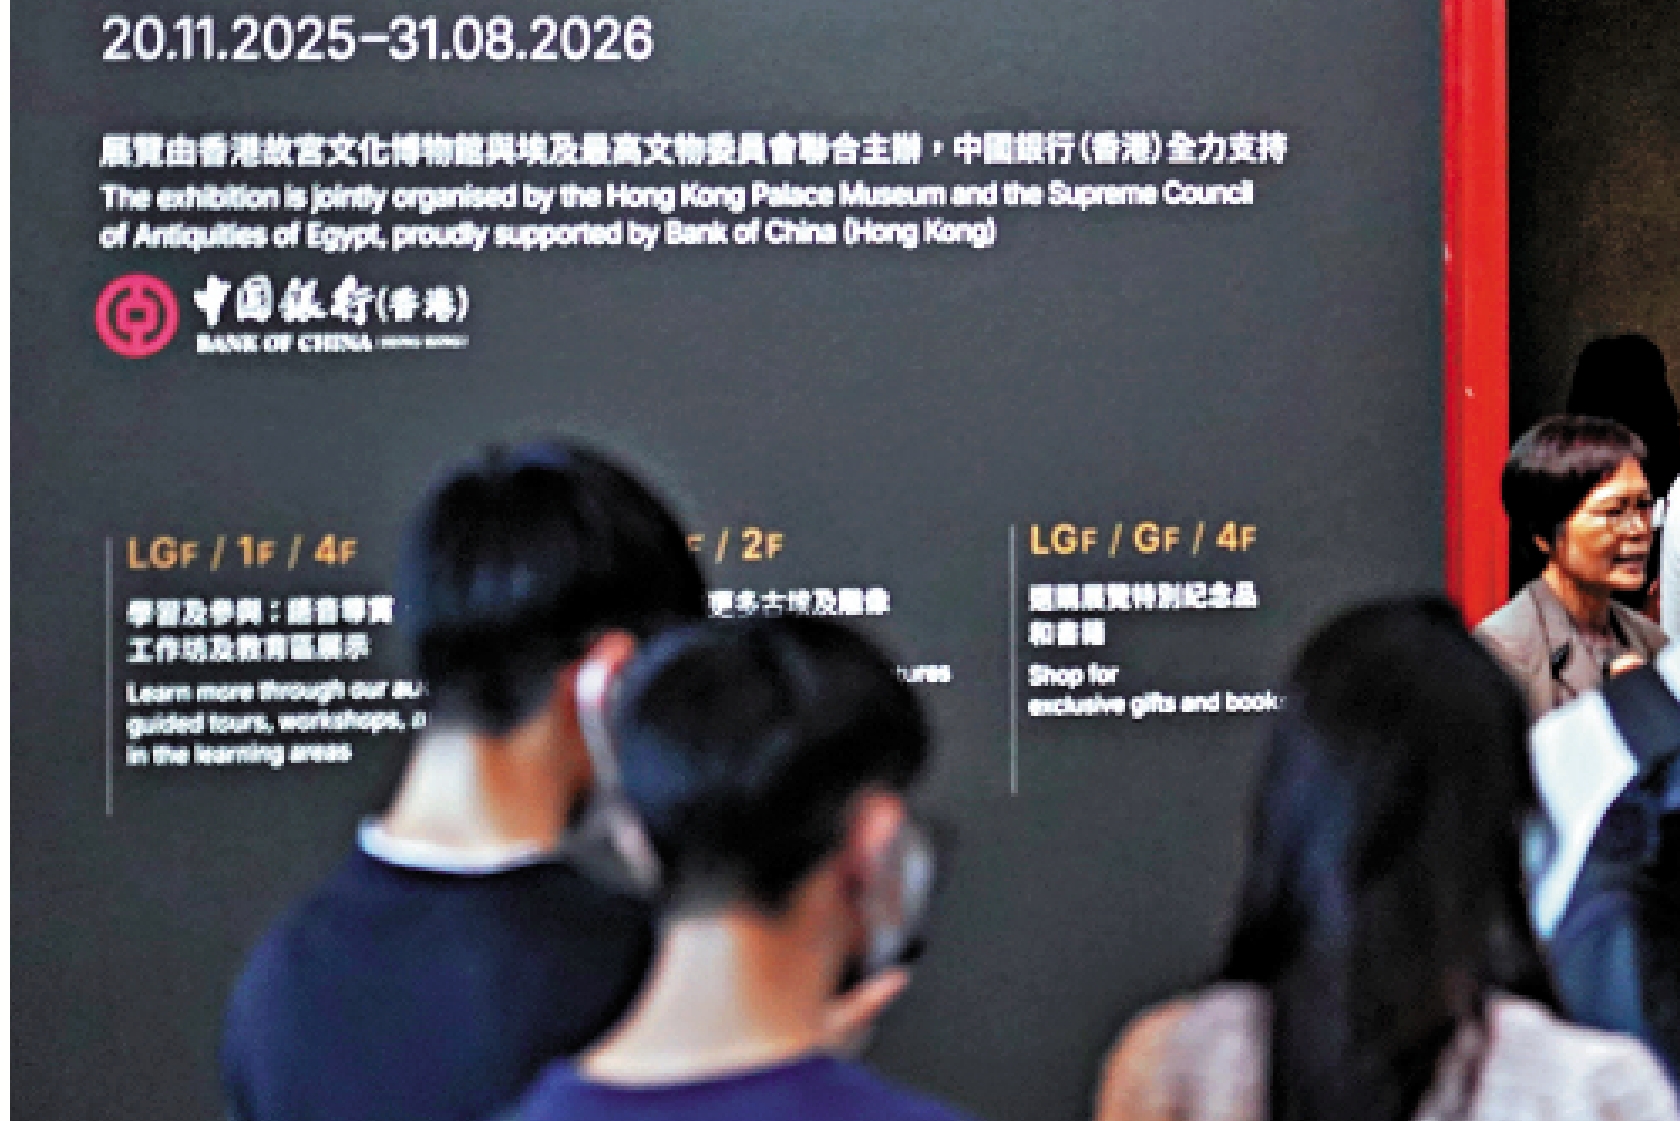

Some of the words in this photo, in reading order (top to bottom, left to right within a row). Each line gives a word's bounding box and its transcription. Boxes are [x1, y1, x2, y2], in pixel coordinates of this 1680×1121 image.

[98, 183, 153, 212] The
[156, 183, 278, 212] exhibition
[283, 183, 309, 212] is
[310, 183, 388, 215] jointly
[391, 183, 517, 215] organised
[522, 183, 557, 215] by
[559, 183, 602, 208] the
[606, 183, 676, 215] Hong
[680, 179, 746, 215] Kong
[751, 179, 835, 208] Palace
[838, 179, 947, 208] Museum
[949, 179, 998, 208] and
[1000, 179, 1044, 208] the
[1047, 179, 1159, 212] Supreme
[1162, 179, 1254, 205] Council
[98, 220, 131, 249] of
[132, 223, 269, 252] Antiquities
[273, 220, 302, 249] of
[307, 220, 388, 254] Egypt,
[391, 220, 495, 252] proudly
[493, 220, 625, 252] supported
[626, 220, 662, 252] by
[663, 216, 729, 245] Bank
[731, 216, 763, 245] of
[764, 216, 837, 245] China
[842, 216, 921, 249] (Hong
[922, 216, 998, 249] Kong)
[236, 536, 275, 565] 1F
[314, 533, 356, 565] 4F
[741, 526, 783, 562] 2F
[1134, 520, 1180, 555] GF
[1215, 520, 1257, 552] 4F
[1027, 664, 1086, 690] Shop
[1087, 661, 1120, 687] for
[125, 681, 191, 703] Learn
[196, 682, 255, 703] more
[256, 678, 346, 707] through
[347, 681, 390, 700] our
[1027, 695, 1126, 717] exclusive
[1128, 691, 1177, 720] gifts
[1179, 691, 1220, 713] and
[125, 711, 205, 740] guided
[125, 745, 151, 767] in
[152, 745, 191, 766] the
[193, 742, 285, 767] learning
[287, 742, 353, 764] areas
